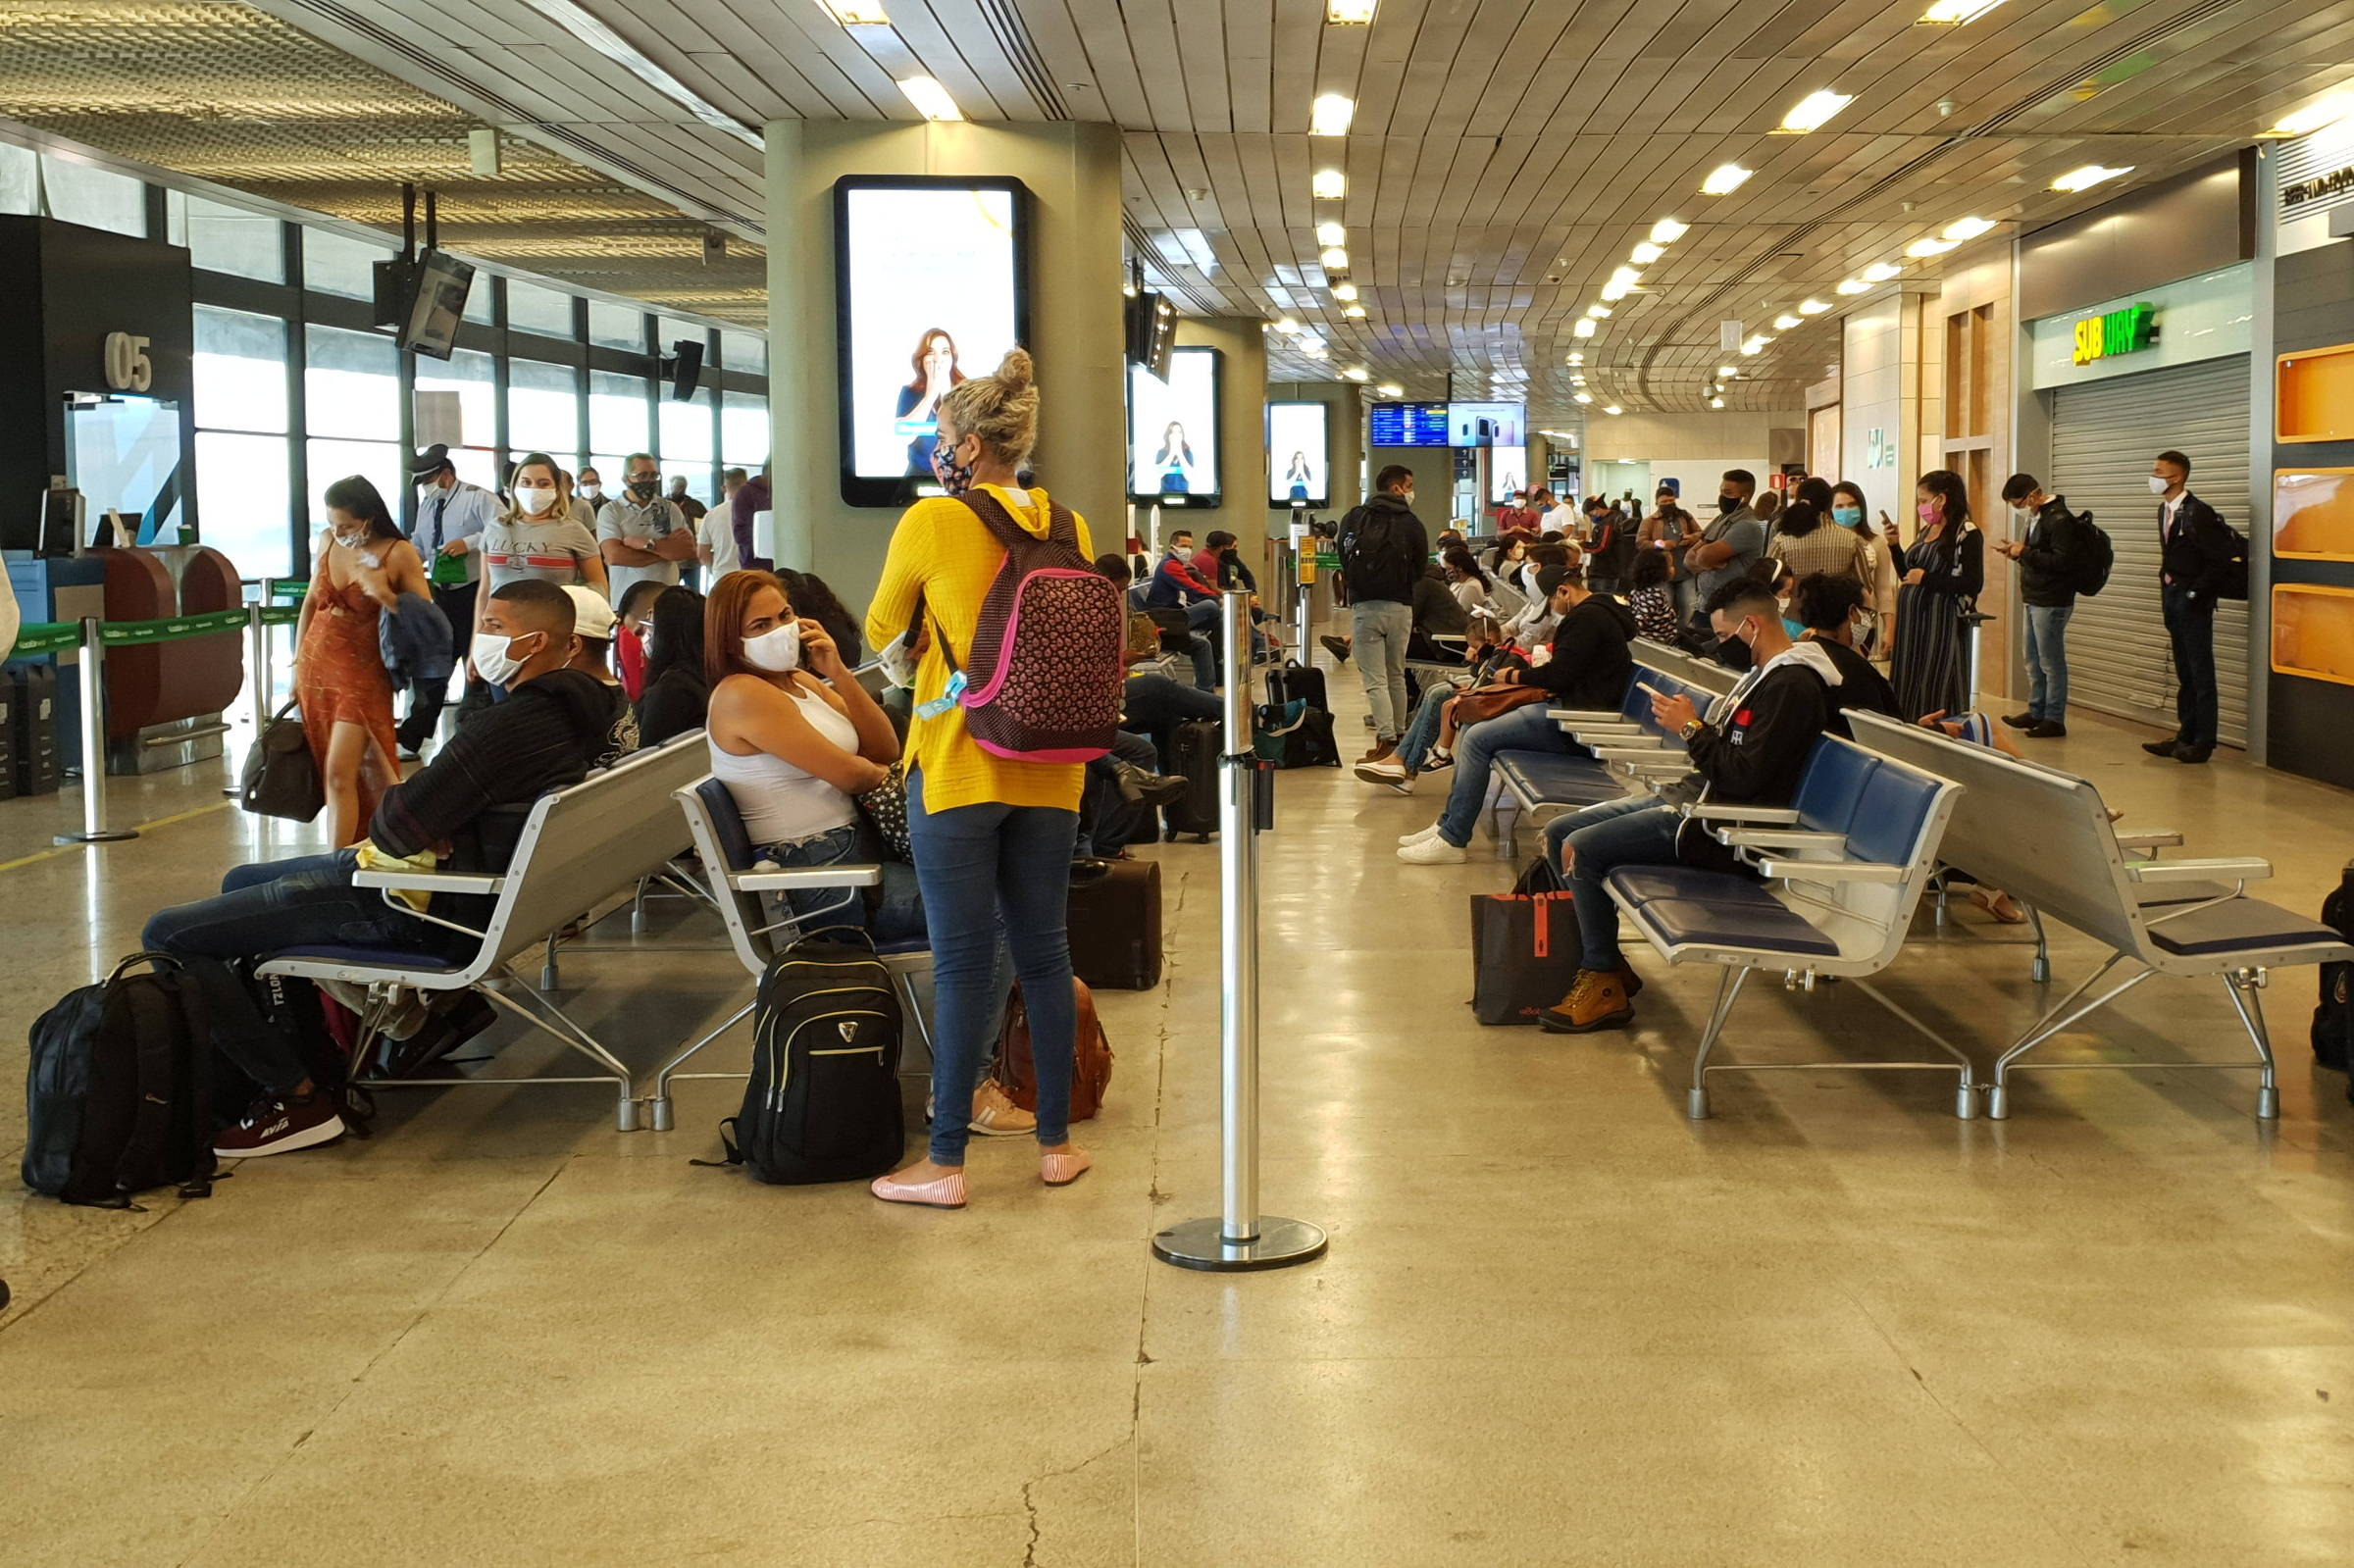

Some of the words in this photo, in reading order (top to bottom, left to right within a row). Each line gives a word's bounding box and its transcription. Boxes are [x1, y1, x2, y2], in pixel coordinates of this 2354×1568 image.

[104, 331, 152, 392] 05
[2073, 304, 2145, 363] SUBWAY
[491, 538, 548, 553] LUCKY
